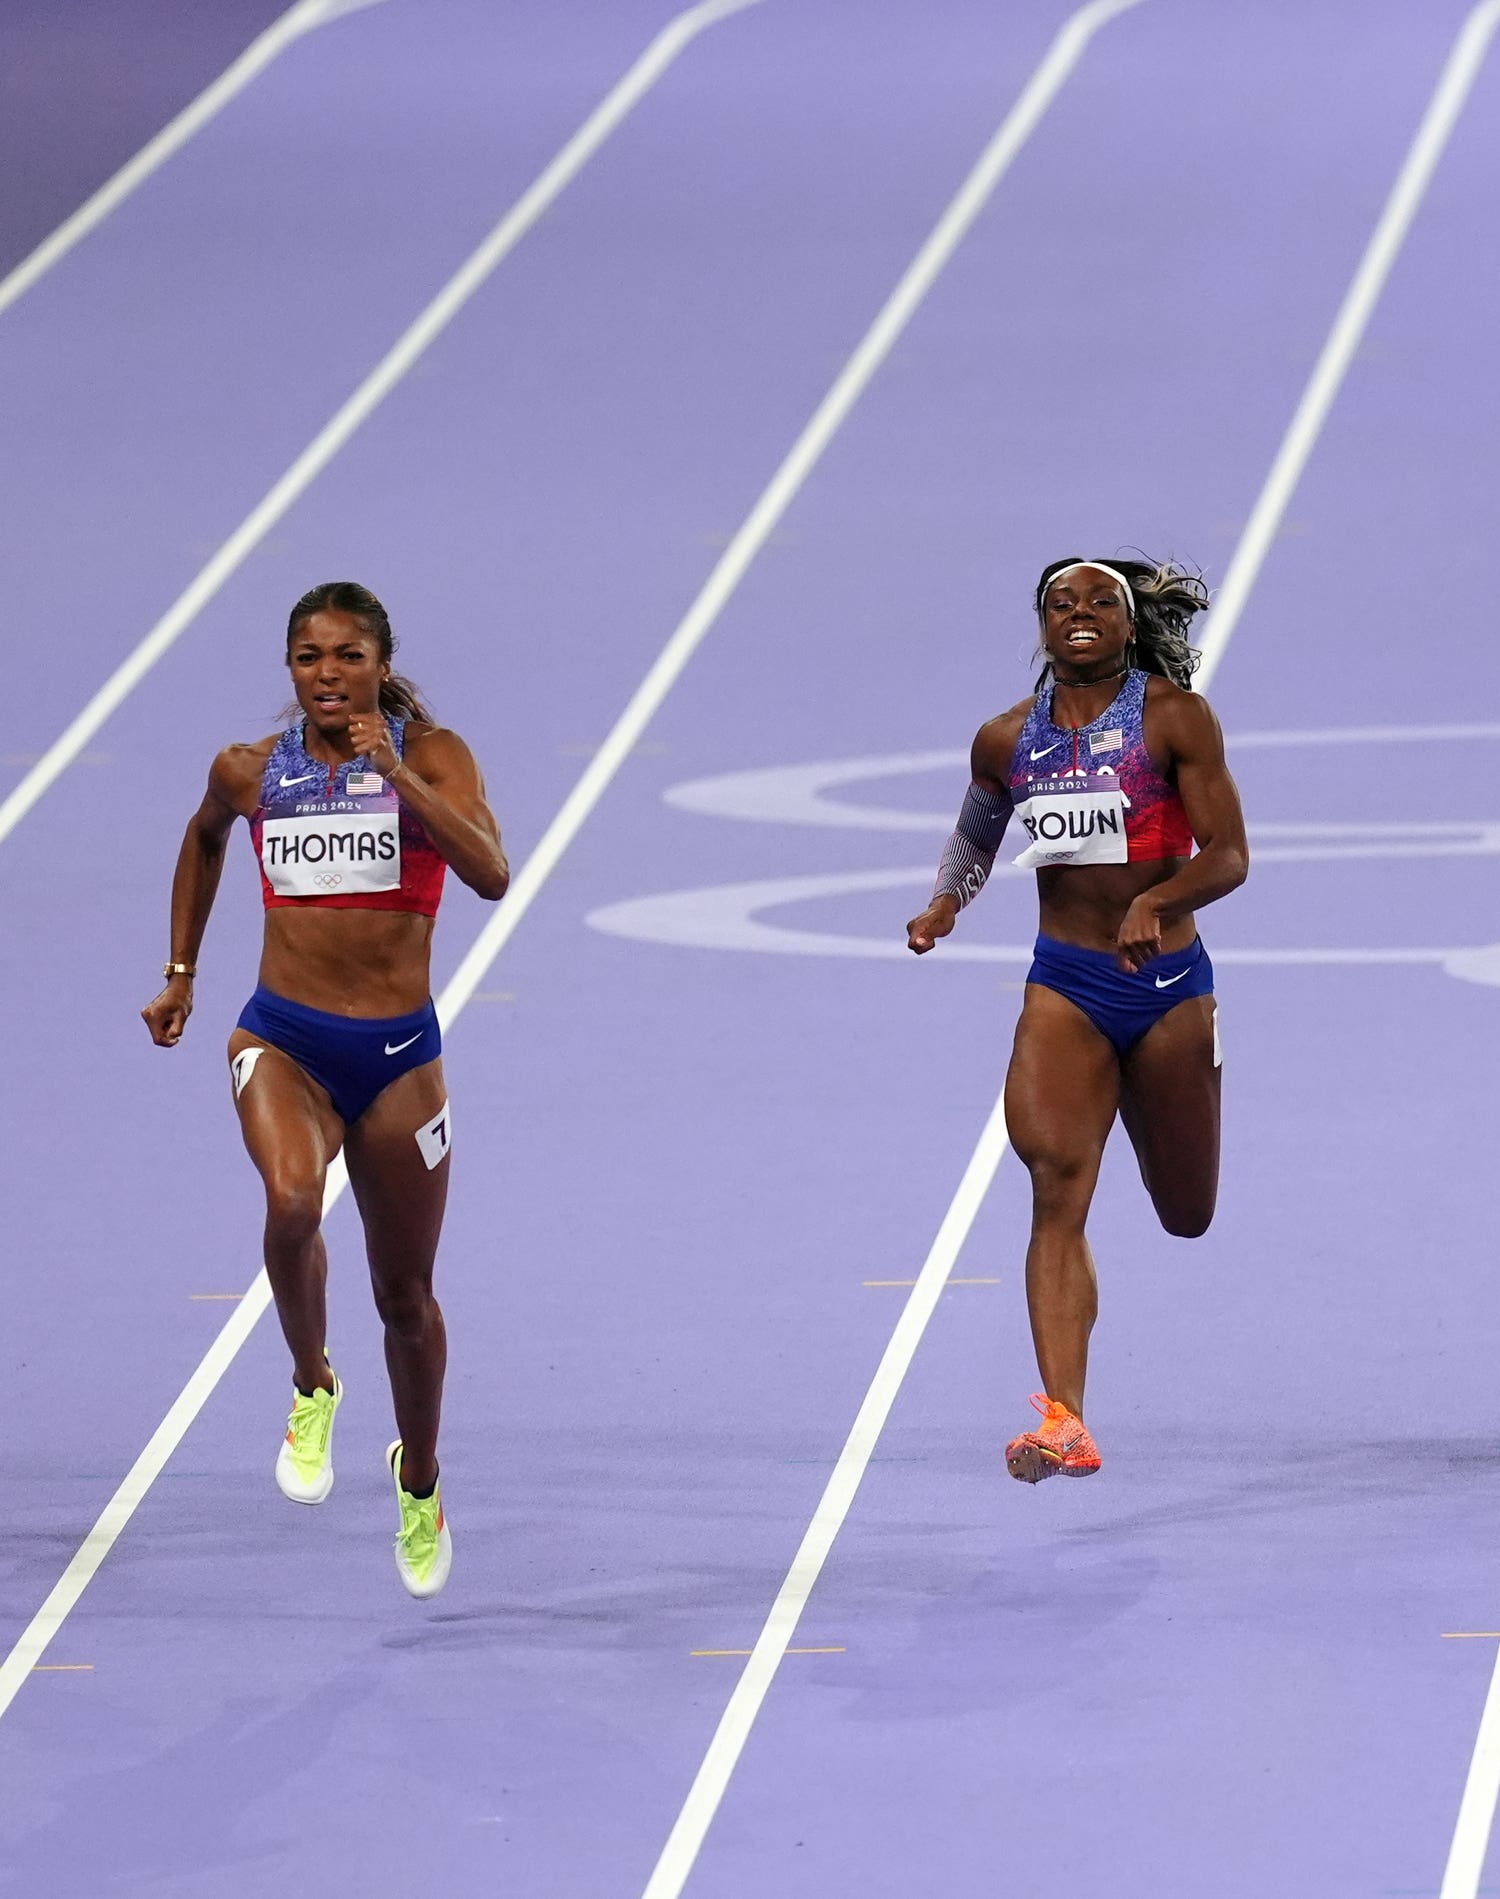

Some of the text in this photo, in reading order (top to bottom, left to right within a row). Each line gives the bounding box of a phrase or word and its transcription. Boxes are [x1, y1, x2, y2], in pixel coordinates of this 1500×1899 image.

[1059, 781, 1088, 790] 2024
[295, 801, 361, 813] PARIS 2024
[1023, 808, 1119, 841] ROWN
[266, 831, 396, 865] THOMAS
[956, 863, 987, 910] USA
[431, 1118, 447, 1147] 7
